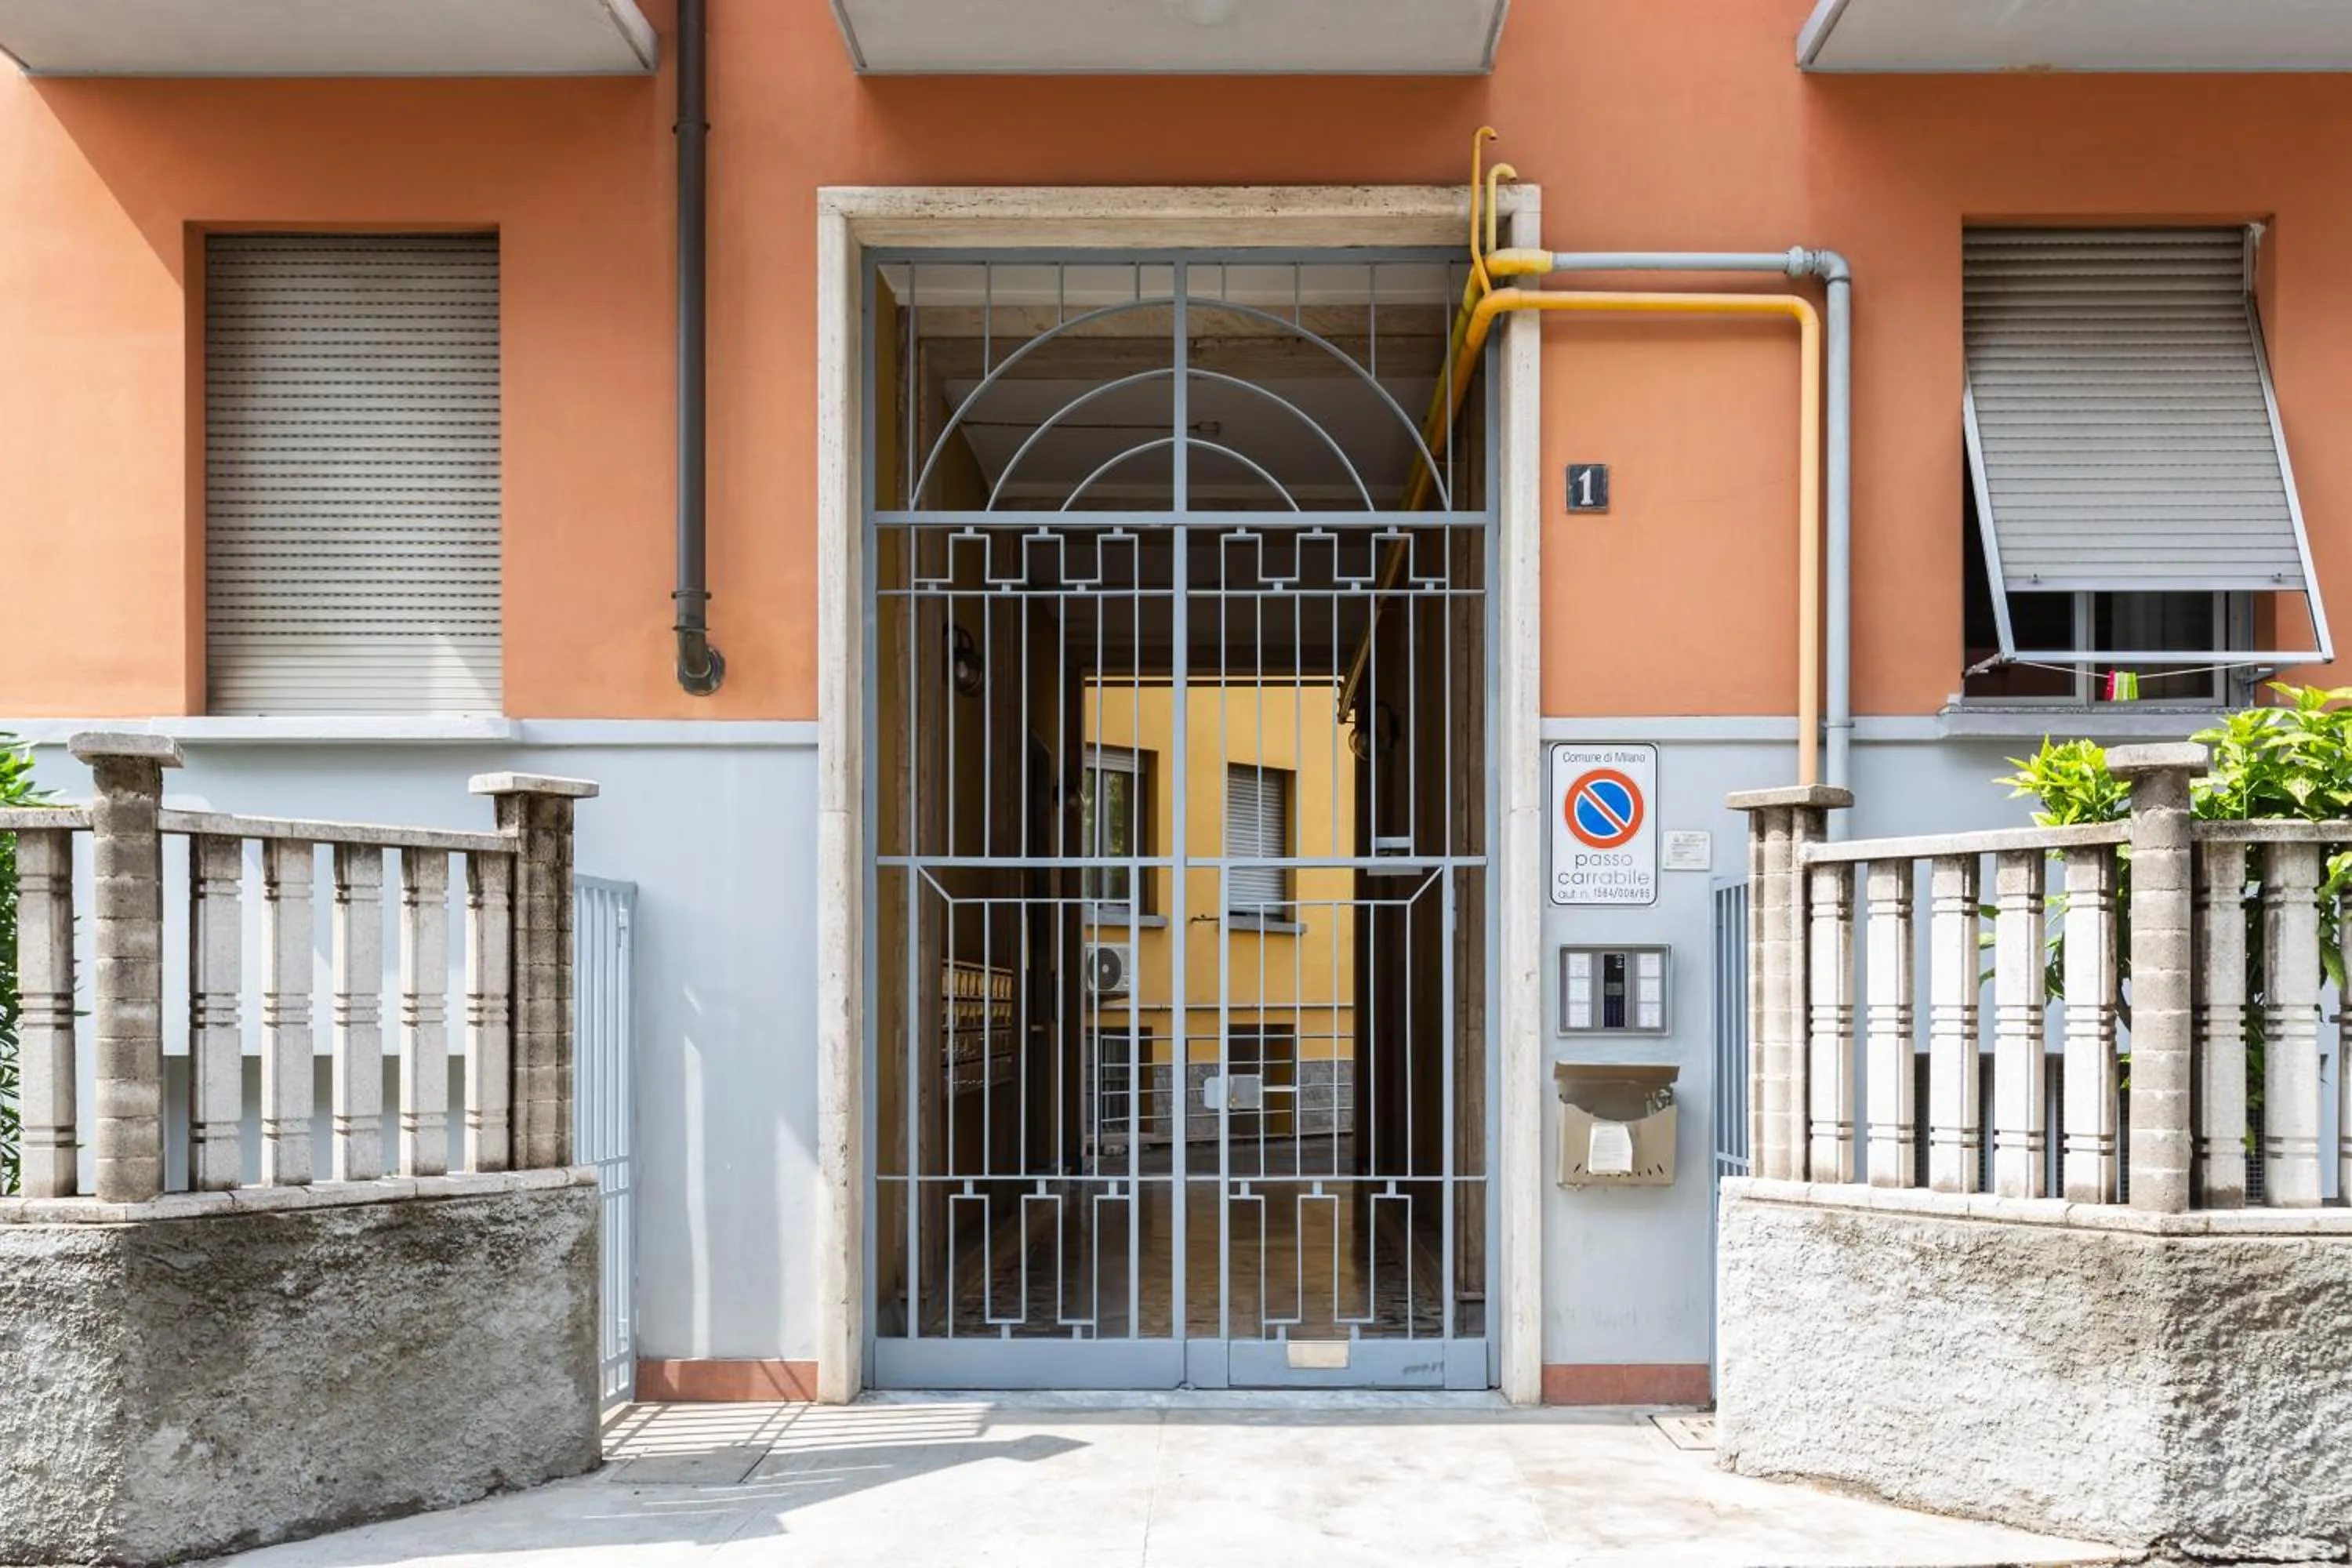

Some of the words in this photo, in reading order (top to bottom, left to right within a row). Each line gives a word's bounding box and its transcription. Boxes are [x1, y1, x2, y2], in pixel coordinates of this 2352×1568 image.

[1578, 468, 1594, 506] 1
[1563, 751, 1602, 763] Comune
[1603, 752, 1613, 763] di
[1614, 752, 1646, 763] Milano
[1574, 853, 1632, 869] passo
[1558, 869, 1650, 885] carrabile
